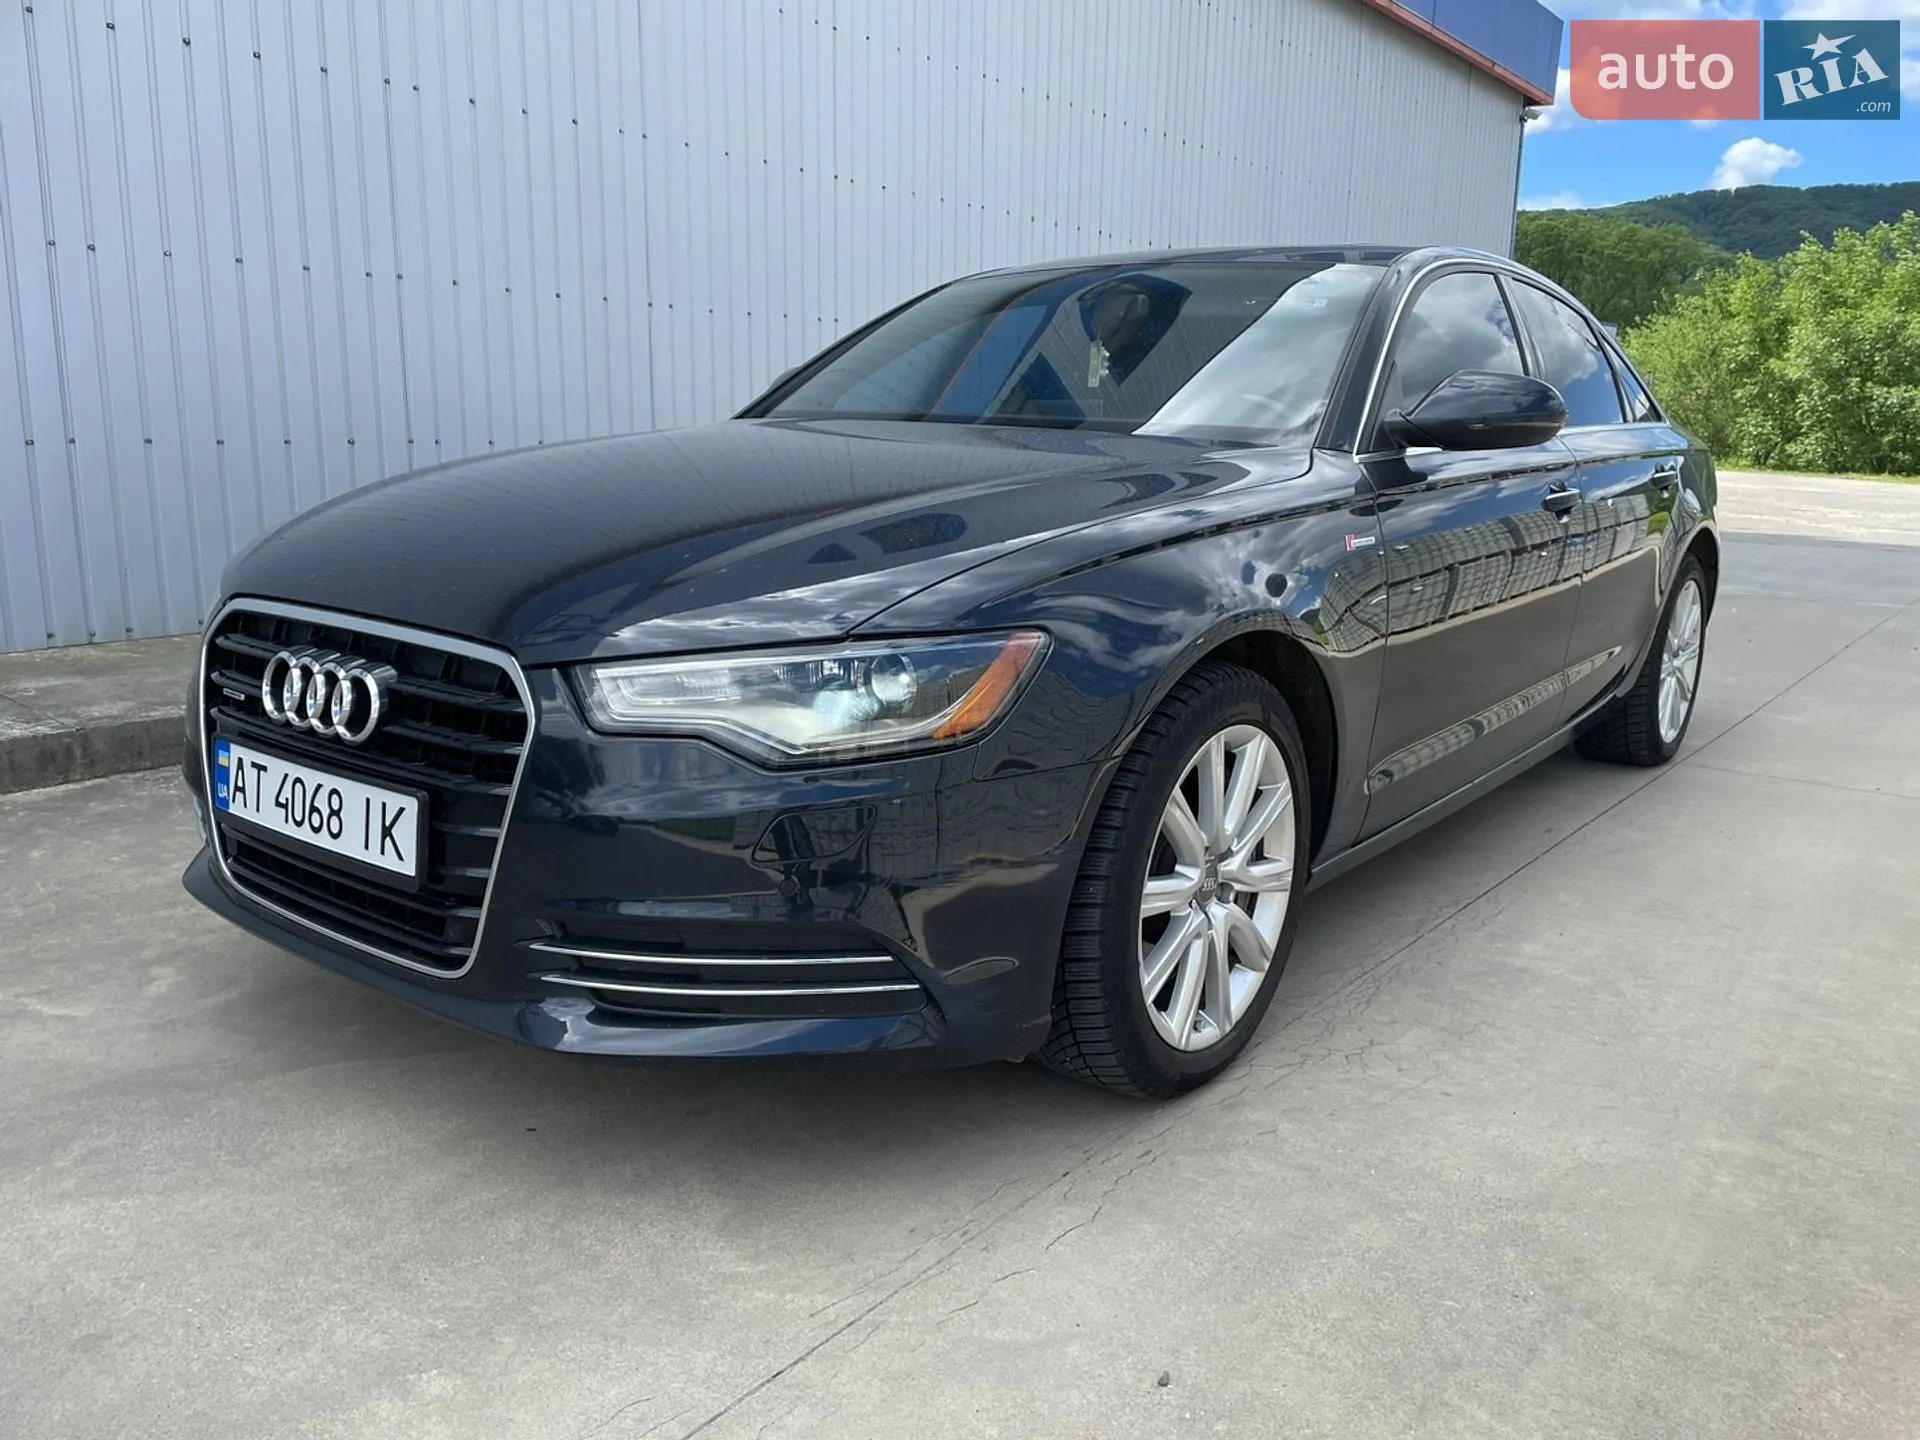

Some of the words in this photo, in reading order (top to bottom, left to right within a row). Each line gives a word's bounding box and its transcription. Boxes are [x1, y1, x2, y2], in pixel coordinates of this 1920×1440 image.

[217, 782, 229, 800] UA
[231, 756, 268, 813] AT
[274, 772, 343, 840] 4068
[363, 796, 406, 862] IK
